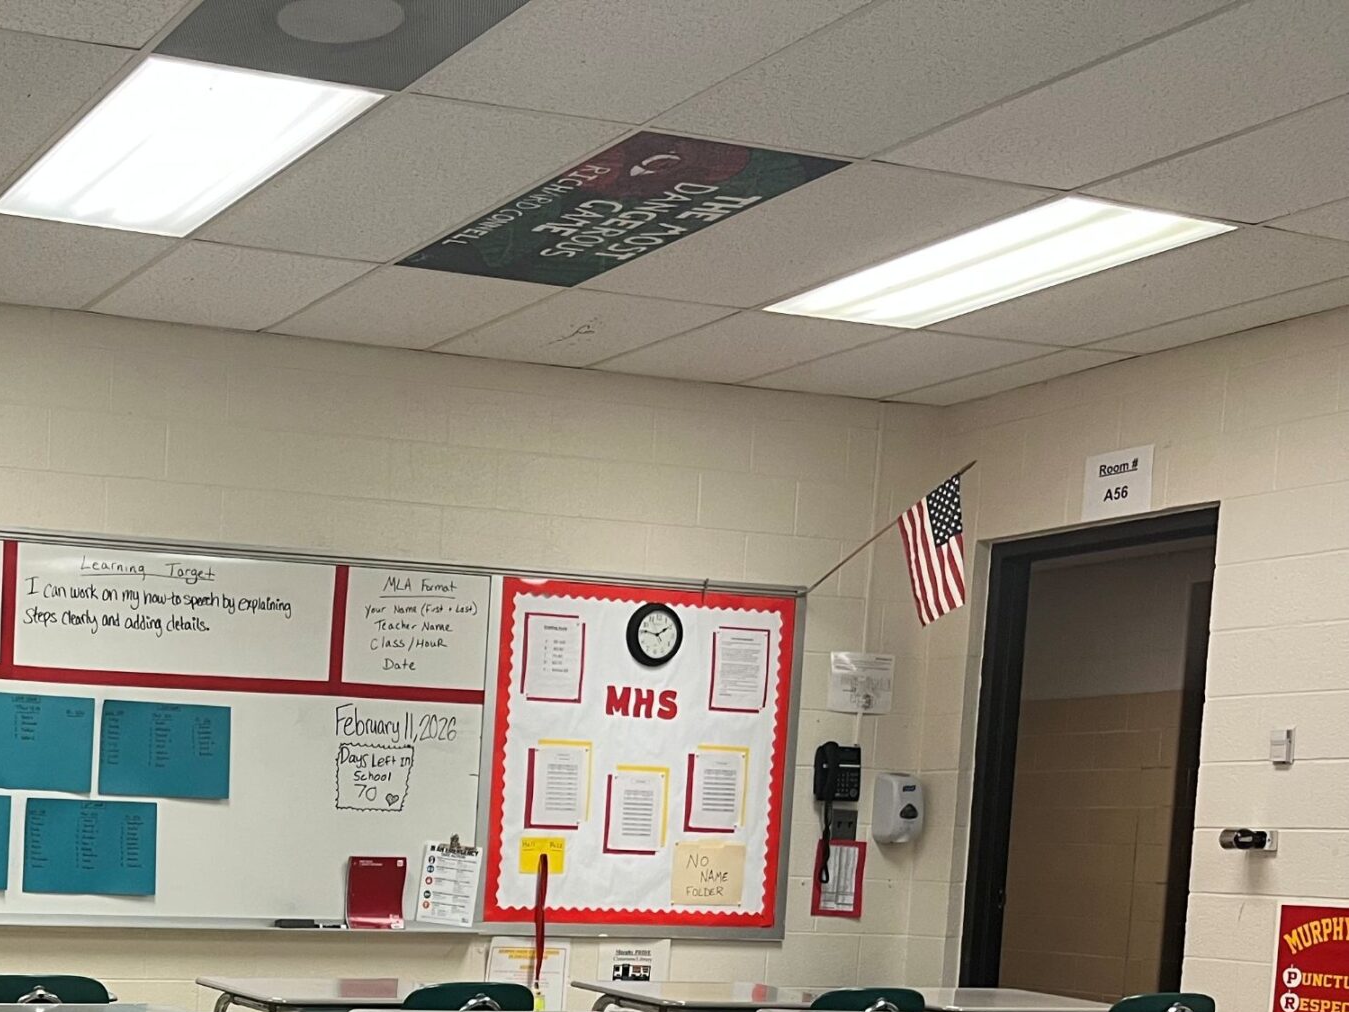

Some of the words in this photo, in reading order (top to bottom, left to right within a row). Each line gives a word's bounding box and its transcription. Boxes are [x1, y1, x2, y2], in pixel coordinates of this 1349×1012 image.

[675, 195, 762, 222] THE
[531, 200, 623, 237] GAME
[540, 182, 719, 258] DANGEROUS
[595, 222, 688, 261] MOST
[1099, 462, 1129, 477] Room
[1103, 485, 1128, 502] A56
[80, 555, 146, 581] Learning
[165, 562, 215, 584] Target
[383, 576, 411, 592] MLA
[421, 578, 458, 592] Format
[25, 576, 39, 595] I
[70, 583, 99, 599] work
[102, 588, 118, 601] on
[122, 589, 140, 610] my
[183, 592, 220, 610] speech
[222, 593, 236, 614] by
[238, 596, 292, 619] explaining
[394, 604, 417, 613] Name
[102, 613, 120, 626] and
[124, 614, 162, 638] adding
[166, 614, 210, 632] details.
[374, 619, 417, 631] Teacher
[421, 621, 453, 632] Name
[382, 658, 416, 670] Date
[605, 684, 679, 720] MHS
[335, 702, 400, 743] February
[340, 746, 369, 768] Days
[372, 753, 396, 768] Left
[354, 770, 391, 781] School
[354, 783, 377, 801] 70
[686, 854, 709, 869] NO
[700, 869, 728, 883] NAME
[685, 885, 724, 897] FOLDER
